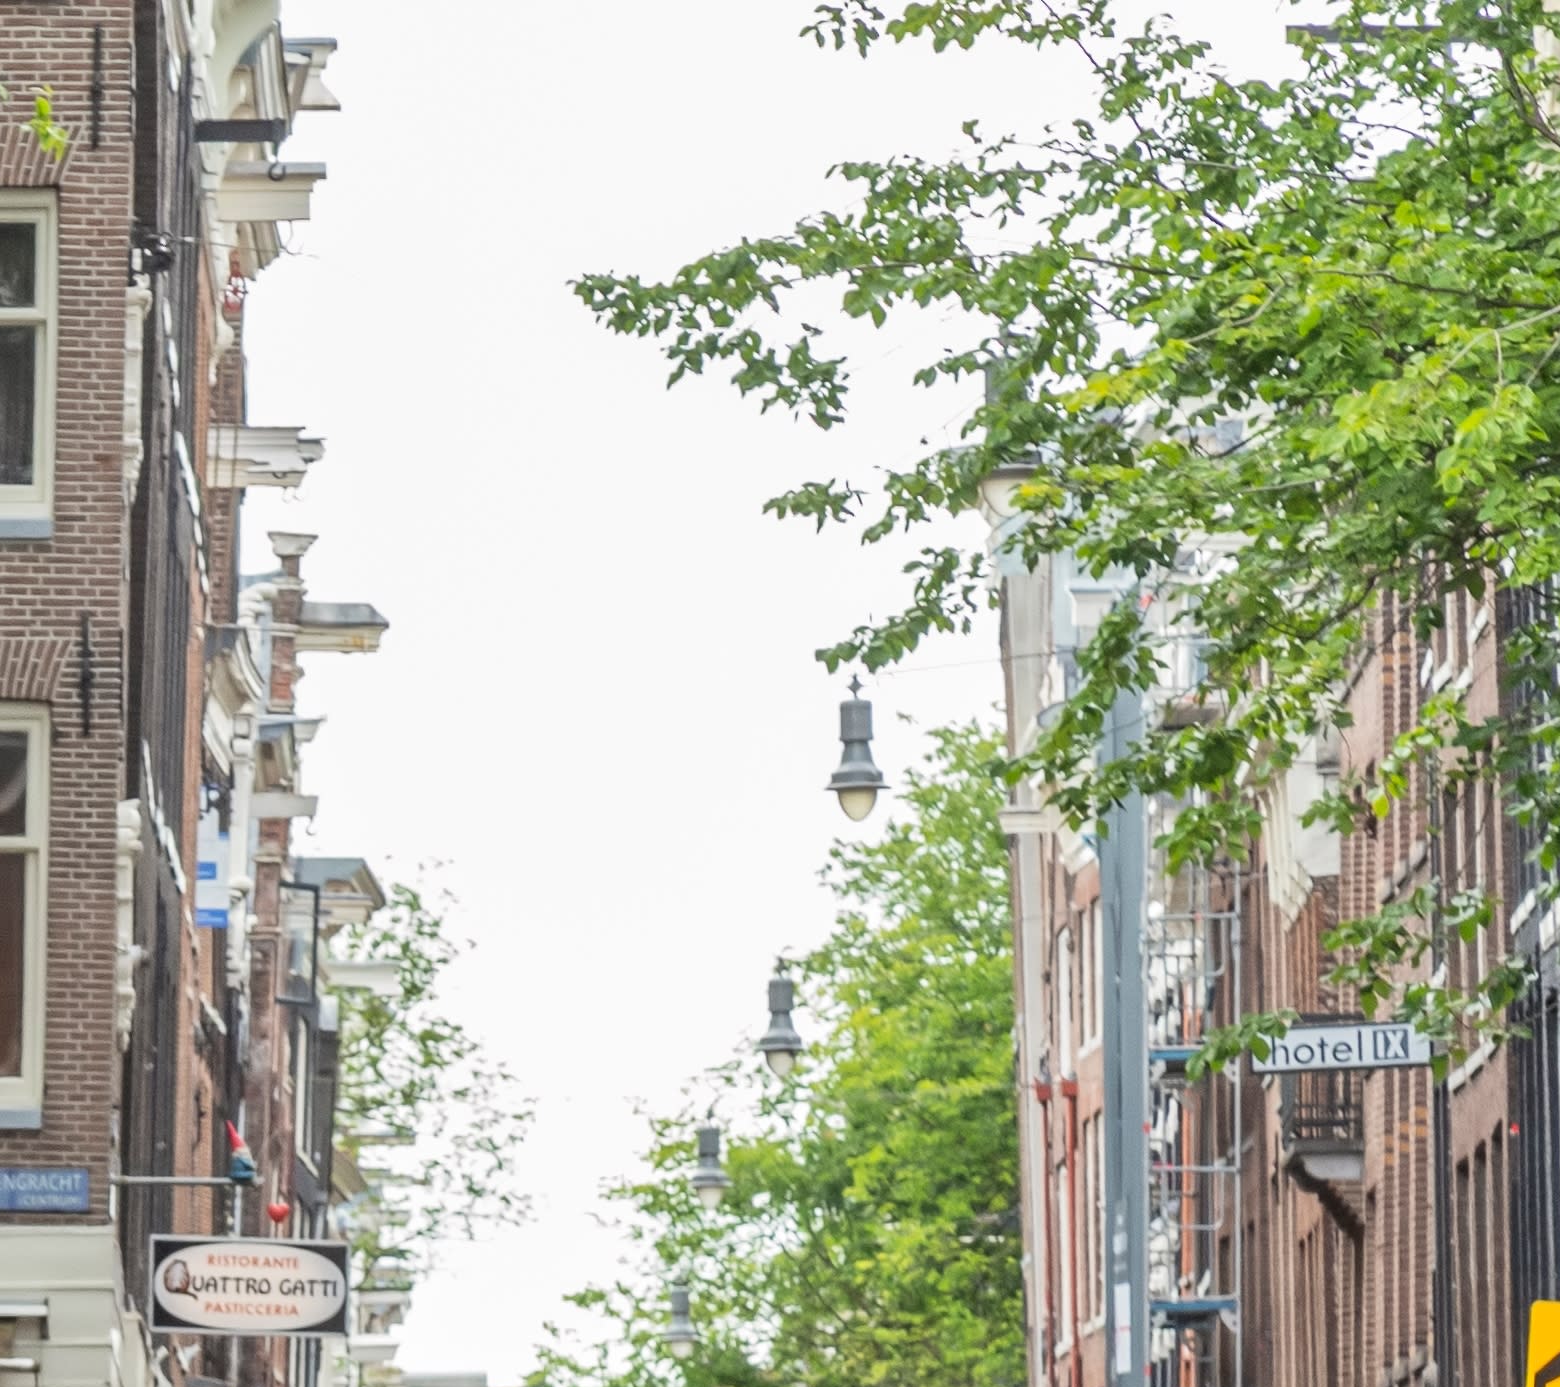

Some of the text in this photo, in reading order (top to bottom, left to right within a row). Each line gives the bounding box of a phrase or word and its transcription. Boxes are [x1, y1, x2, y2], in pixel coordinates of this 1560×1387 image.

[1271, 1030, 1407, 1066] hotel IX
[207, 1254, 300, 1269] RISTORANTE
[163, 1259, 337, 1300] QUATTRO GATTI
[204, 1302, 299, 1316] PASTICCERIA
